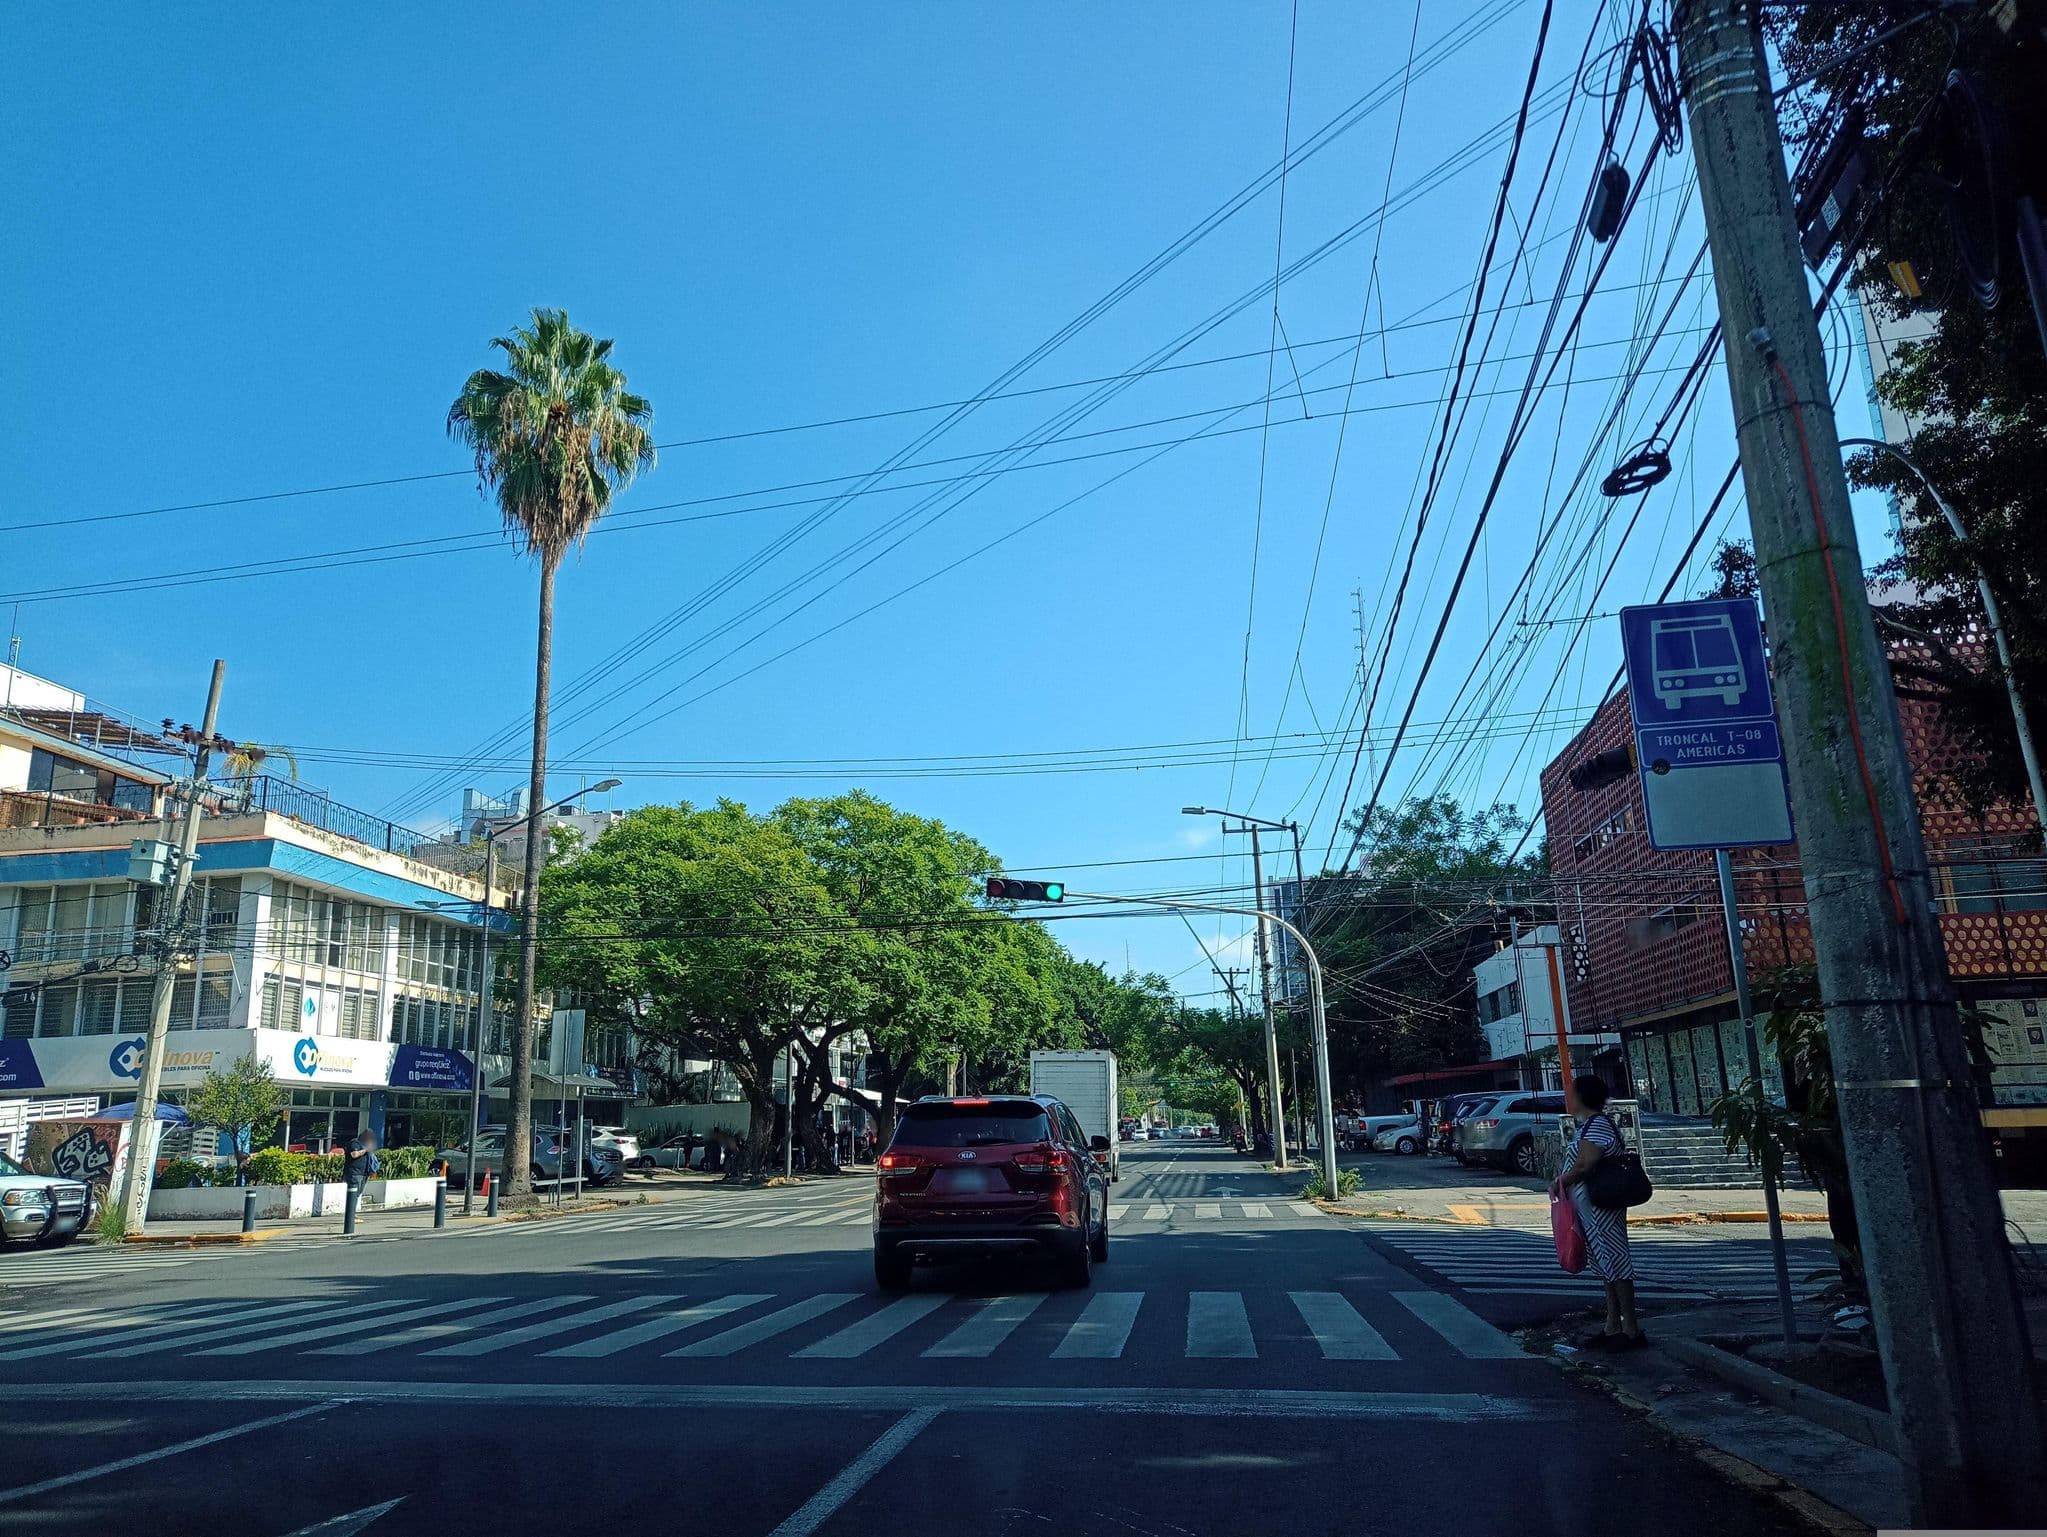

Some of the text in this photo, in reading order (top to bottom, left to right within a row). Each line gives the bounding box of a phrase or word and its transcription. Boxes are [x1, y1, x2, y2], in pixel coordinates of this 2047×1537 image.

[1656, 729, 1762, 746] TRONCAL T-08
[1676, 744, 1746, 759] AMERICAS
